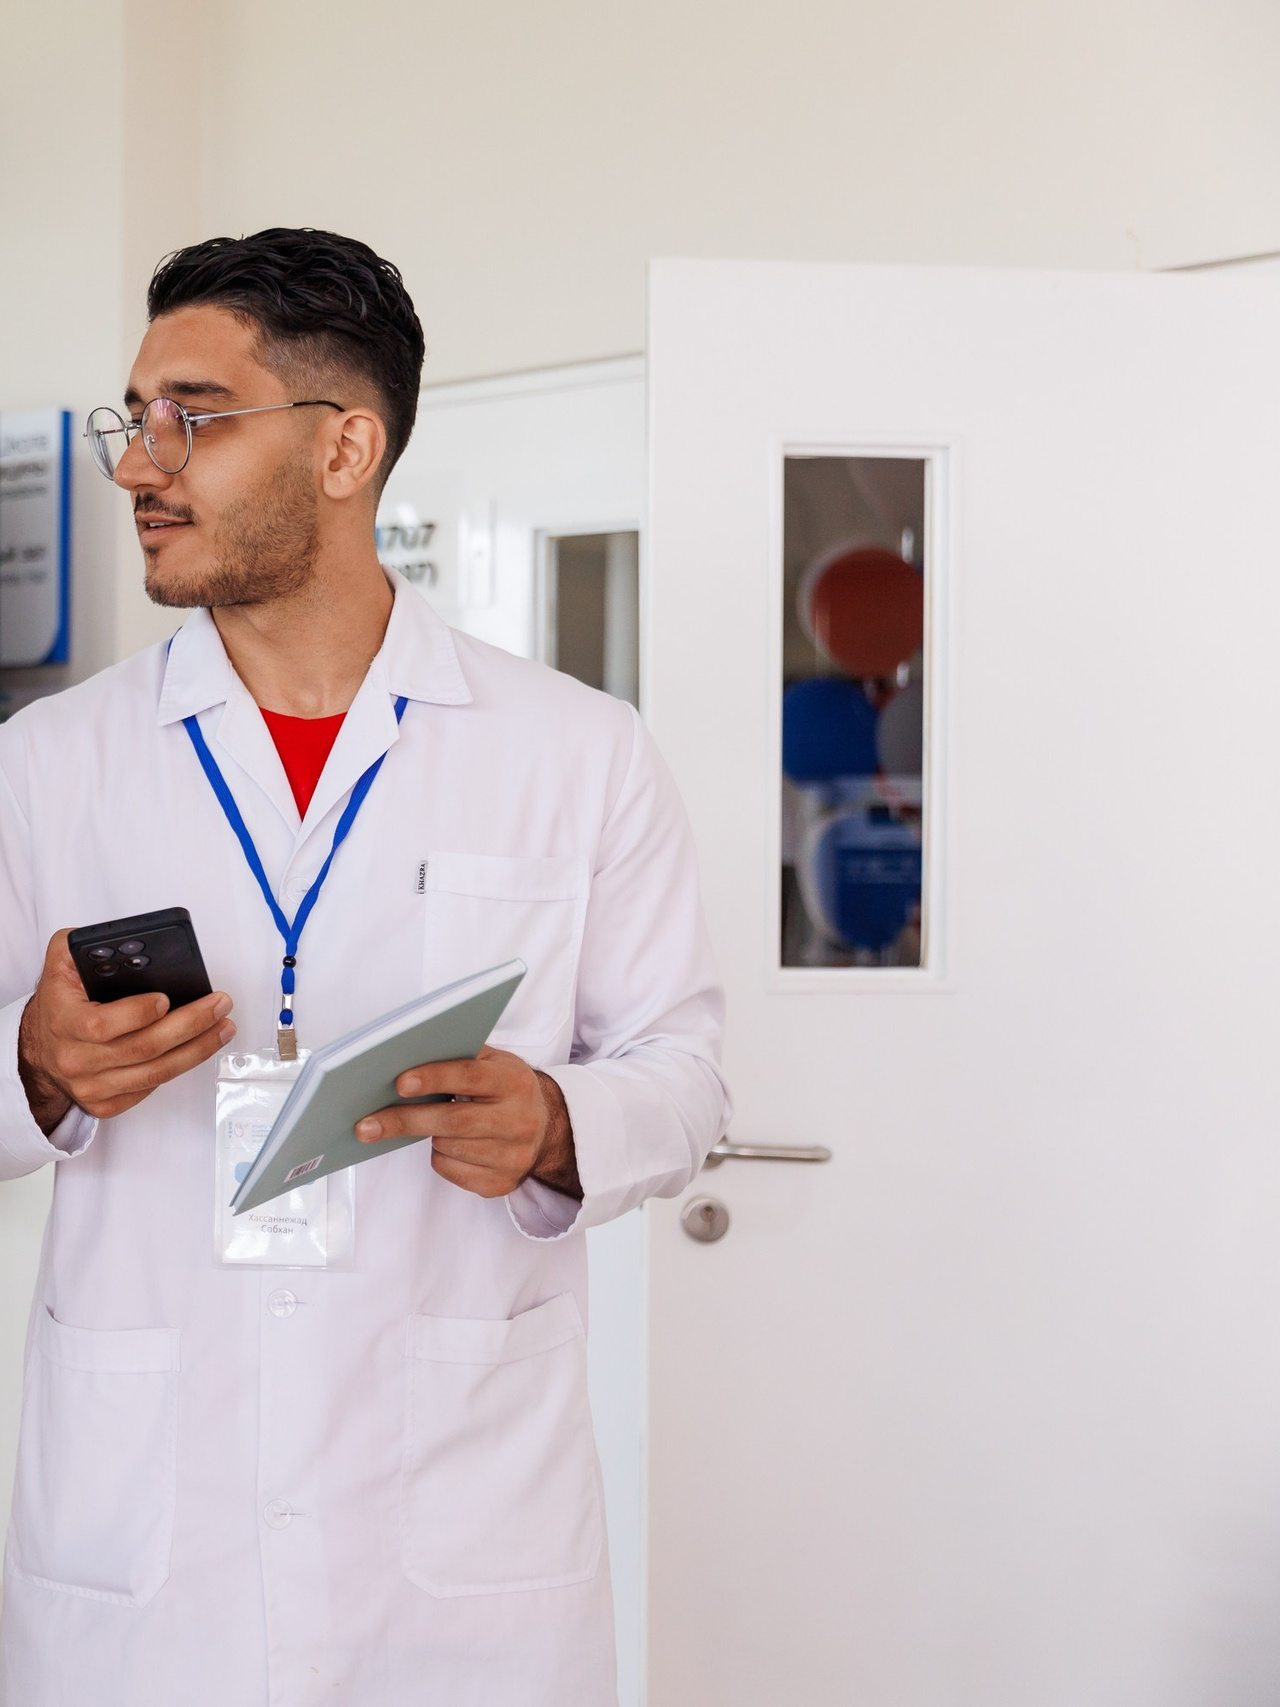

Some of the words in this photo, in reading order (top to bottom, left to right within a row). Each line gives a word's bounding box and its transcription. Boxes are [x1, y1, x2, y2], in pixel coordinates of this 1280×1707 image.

[417, 863, 426, 890] KHAZRA
[248, 1213, 308, 1227] Хассаннежад
[261, 1224, 294, 1235] Собхан
